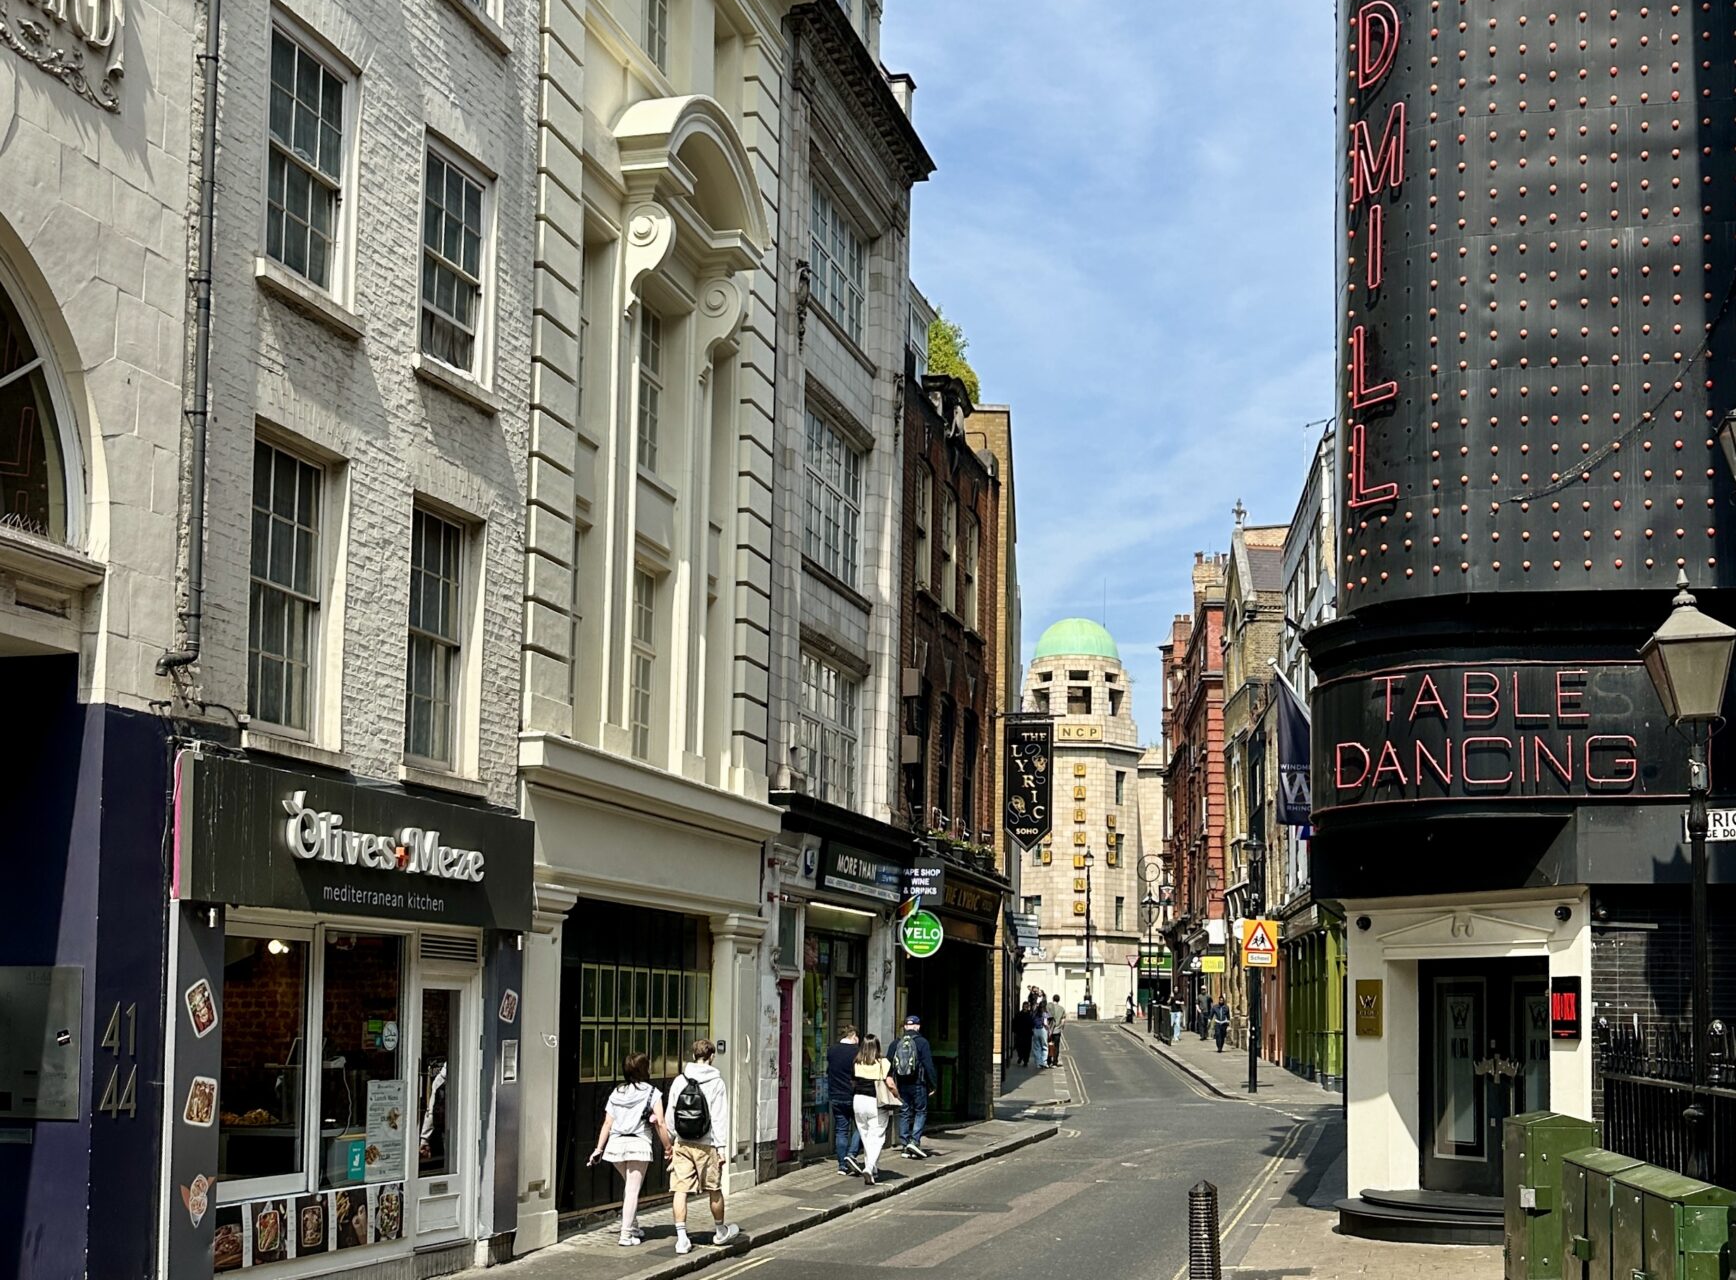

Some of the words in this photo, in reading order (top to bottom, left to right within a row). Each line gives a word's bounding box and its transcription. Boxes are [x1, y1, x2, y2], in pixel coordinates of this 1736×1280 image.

[1021, 732, 1047, 742] THE
[1062, 728, 1097, 737] NCP
[1335, 734, 1638, 788] DANCING
[1011, 745, 1045, 819] LYRIC
[1016, 827, 1039, 835] SOHO
[1075, 764, 1085, 913] PARKING
[1108, 816, 1116, 863] NCP
[837, 854, 857, 877] MORE
[859, 860, 877, 881] THAN
[920, 868, 941, 877] SHOP
[910, 887, 937, 895] DRINKS
[911, 878, 930, 886] WINE
[323, 885, 404, 908] mediterranean
[407, 891, 445, 912] kitchen
[904, 927, 940, 940] VELO
[101, 1001, 137, 1056] 41
[98, 1064, 137, 1119] 44
